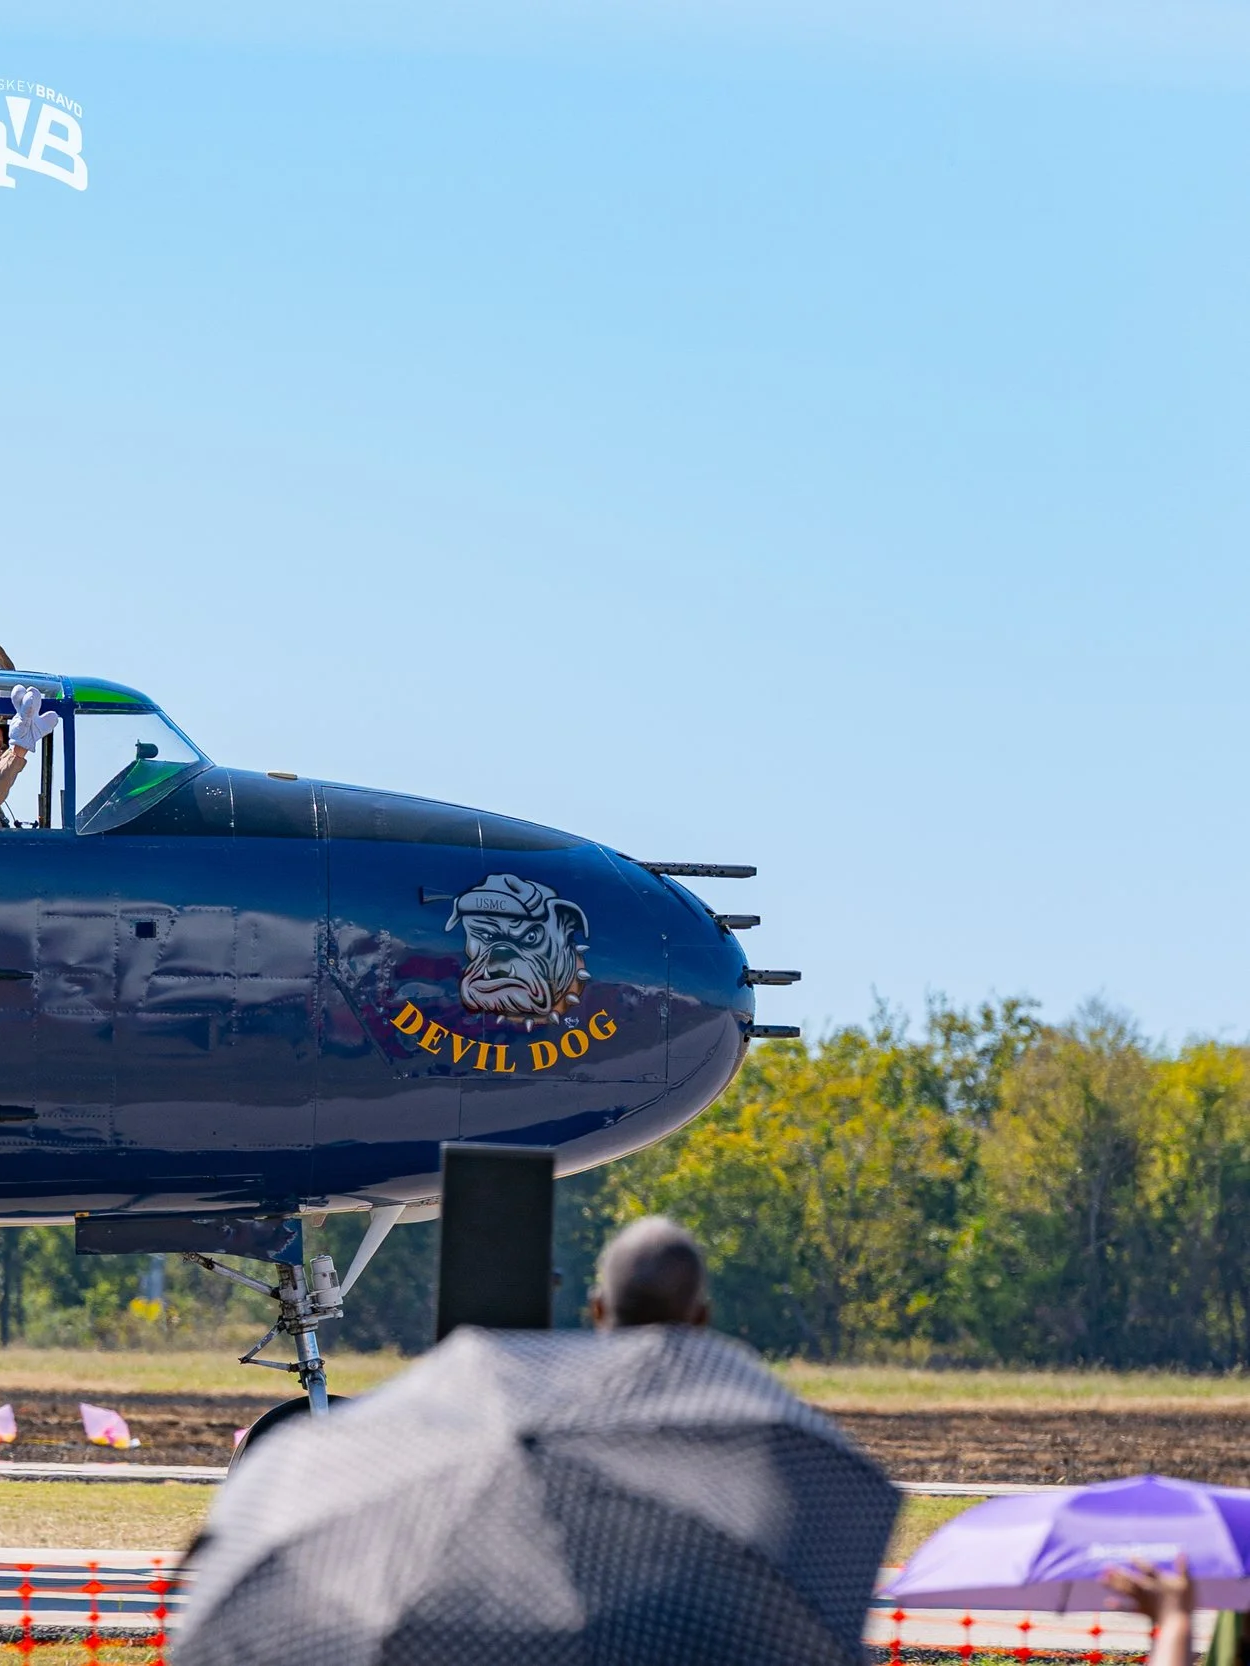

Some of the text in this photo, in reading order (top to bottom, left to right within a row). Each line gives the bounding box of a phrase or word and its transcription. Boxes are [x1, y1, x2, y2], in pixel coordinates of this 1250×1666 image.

[475, 897, 507, 911] USMC
[390, 1001, 618, 1073] DEVIL DOG
